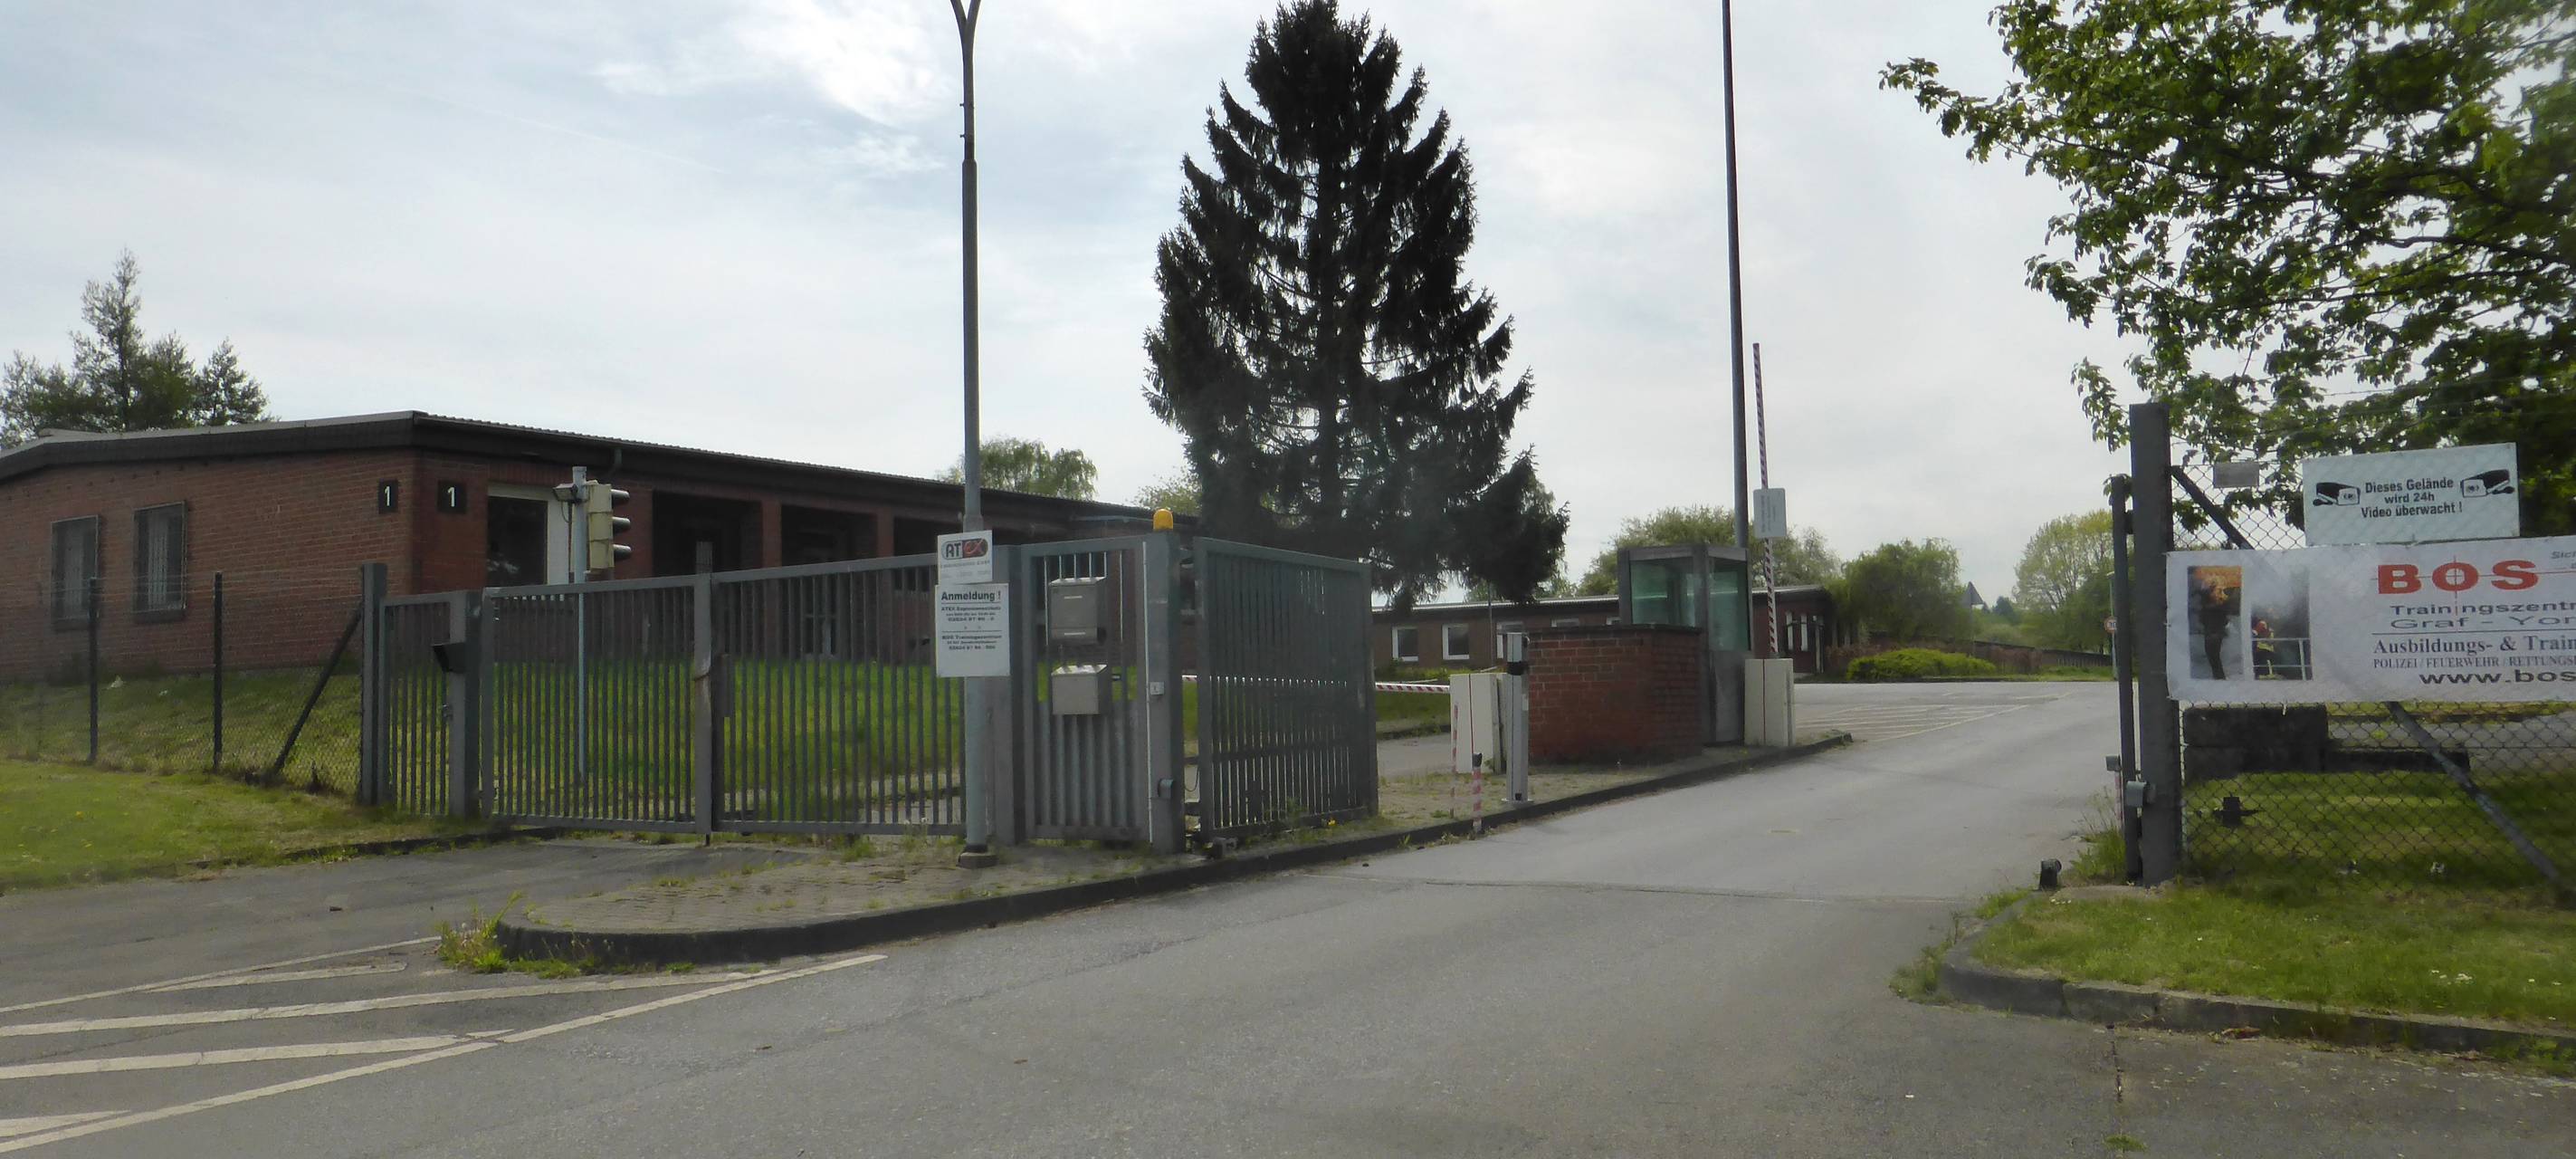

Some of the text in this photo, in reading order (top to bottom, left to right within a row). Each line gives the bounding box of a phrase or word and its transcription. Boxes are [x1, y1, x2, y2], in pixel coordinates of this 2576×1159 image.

[2365, 477, 2454, 493] Dieses Gelände
[385, 486, 390, 506] 1
[448, 487, 455, 507] 1
[2384, 492, 2435, 503] wird 24h
[2361, 501, 2463, 518] Video überwacht !
[2378, 559, 2538, 595] BOS
[941, 590, 995, 602] Anmeldung
[2390, 617, 2469, 628] Graf
[2374, 638, 2493, 656] Ausbildungs-
[2500, 636, 2516, 651] &
[2373, 658, 2419, 669] POLIZEI
[2427, 656, 2500, 668] FEUERWEHR
[2419, 669, 2576, 685] www.bos
